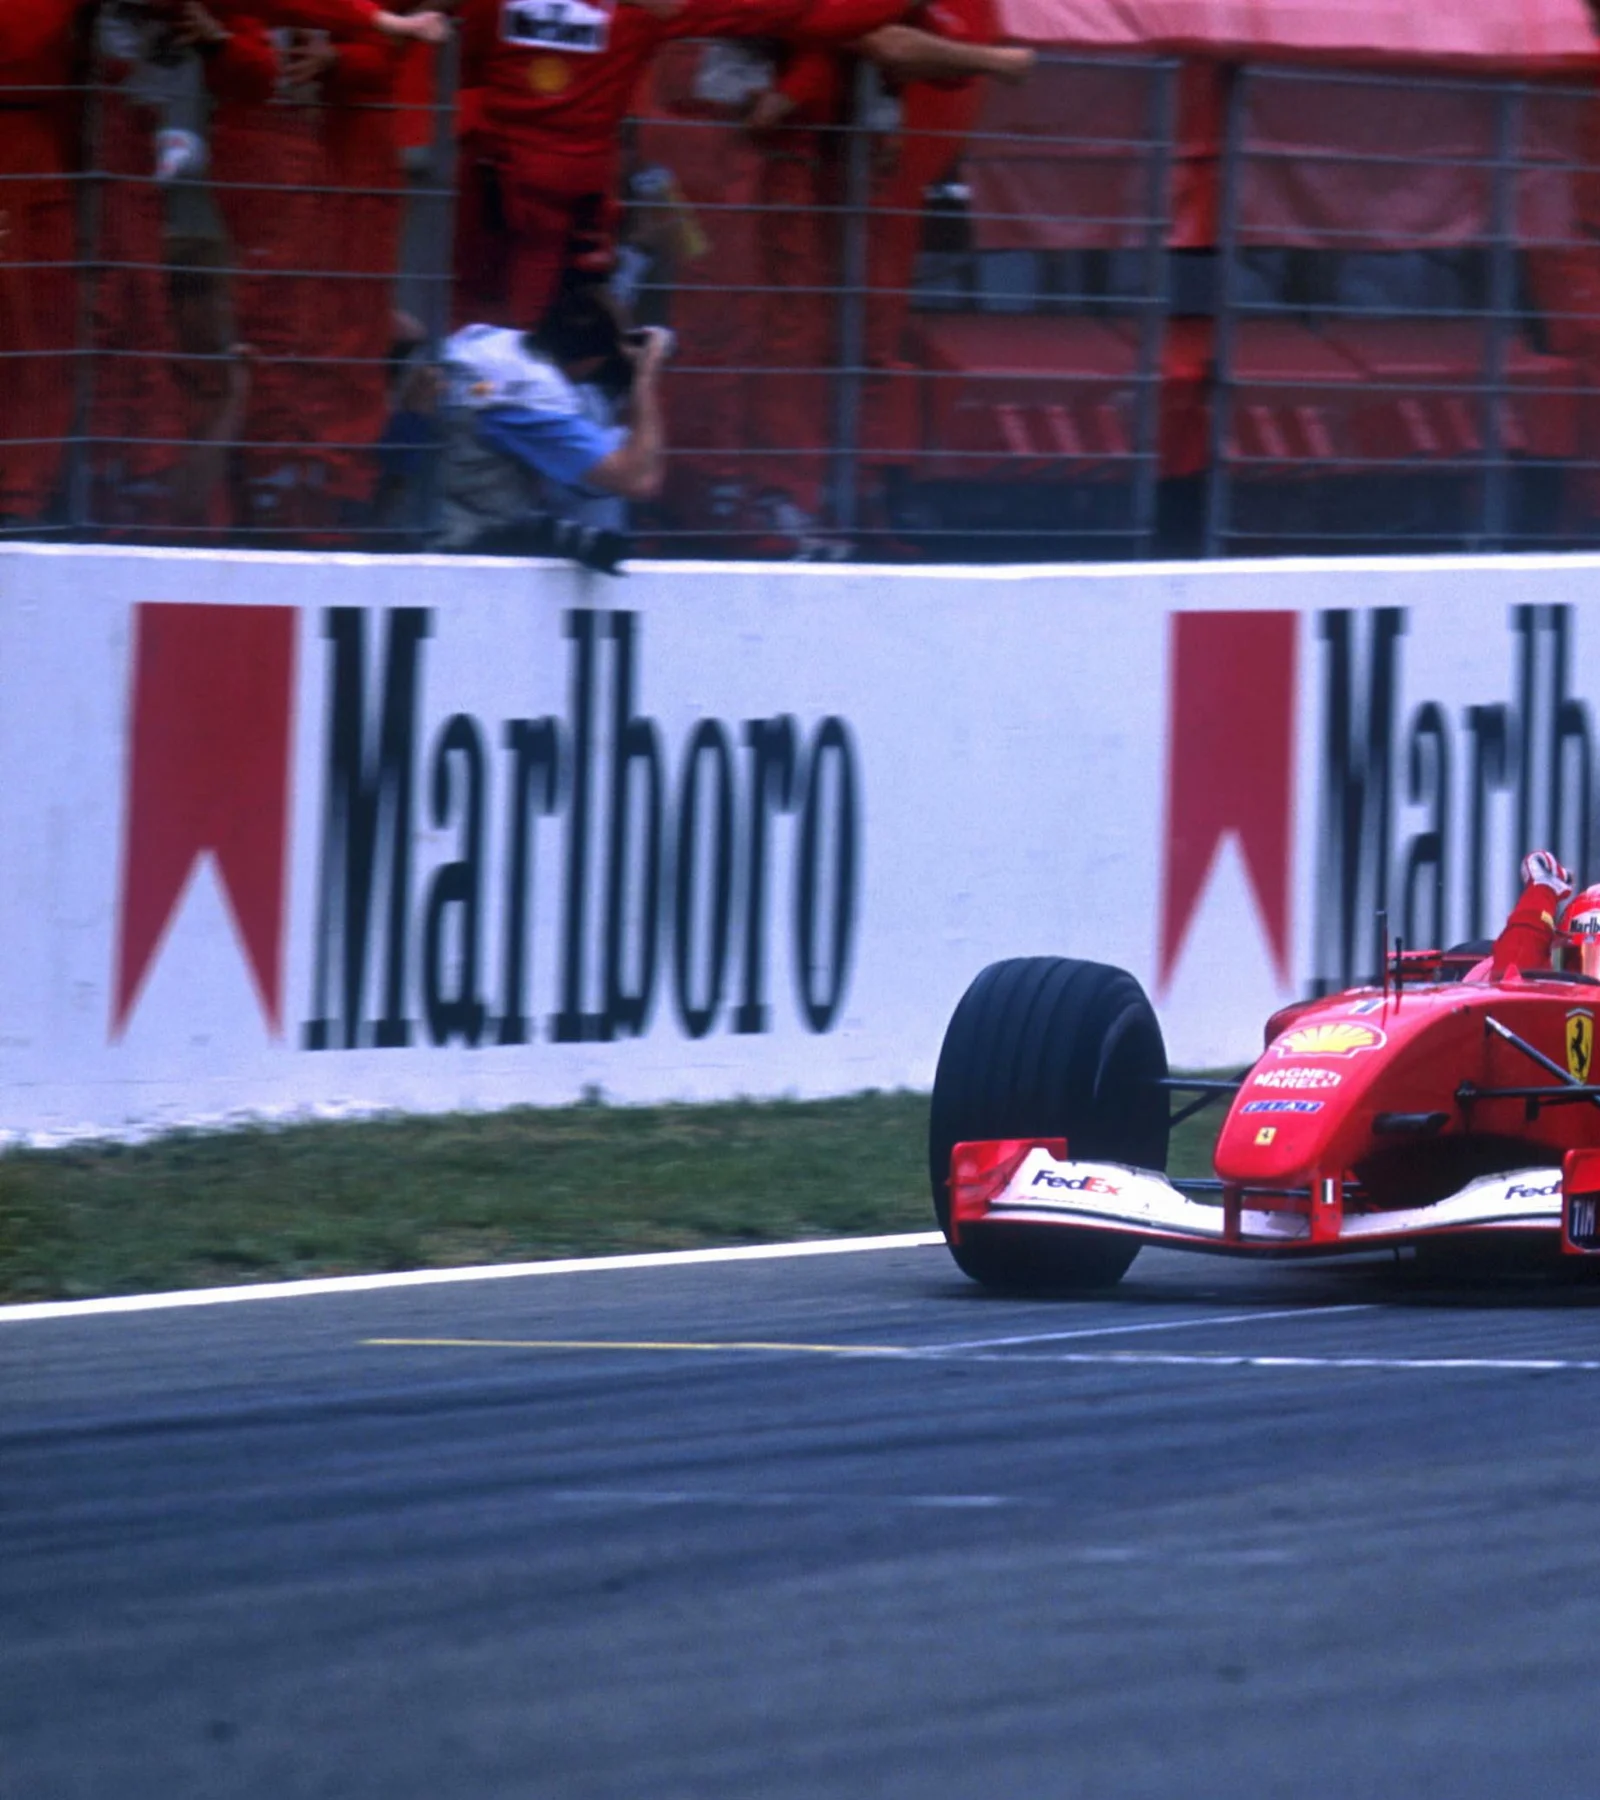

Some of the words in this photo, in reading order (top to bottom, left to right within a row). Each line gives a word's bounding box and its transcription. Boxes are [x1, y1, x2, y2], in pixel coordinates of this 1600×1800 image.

[300, 604, 863, 1051] Marlboro
[1031, 1169, 1122, 1195] FedEx
[1504, 1180, 1562, 1200] Fed
